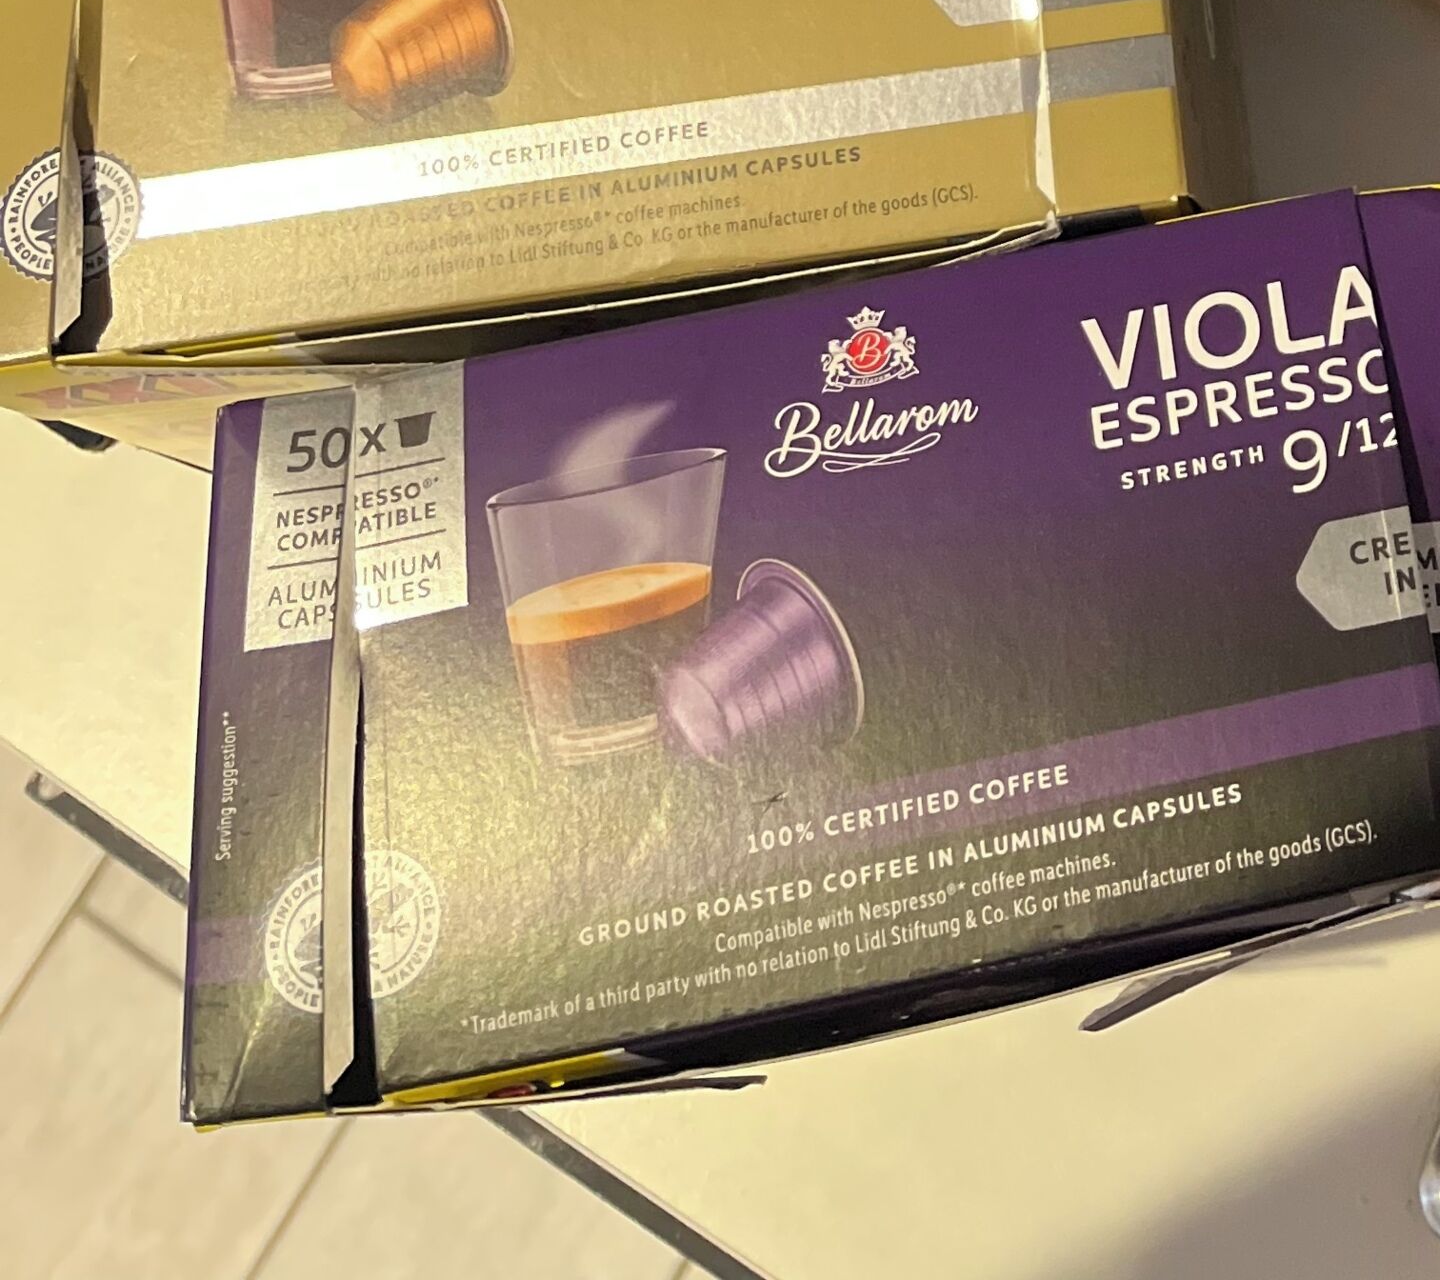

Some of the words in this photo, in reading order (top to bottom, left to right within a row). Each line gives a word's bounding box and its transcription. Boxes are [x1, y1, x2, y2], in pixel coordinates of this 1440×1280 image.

[420, 153, 480, 177] 100%
[489, 136, 610, 167] CERTIFIED
[620, 121, 709, 149] COFFEE
[579, 184, 601, 201] IN
[611, 163, 738, 196] ALUMINIUM
[746, 146, 861, 176] CAPSULES
[541, 239, 604, 260] Stiftung
[608, 234, 619, 250] &
[652, 227, 673, 243] KG
[677, 226, 692, 240] or
[697, 217, 722, 238] the
[726, 206, 829, 236] manufacturer
[833, 202, 848, 220] of
[853, 198, 876, 217] the
[881, 190, 928, 217] goods
[616, 205, 663, 224] coffee
[10, 235, 53, 271] PEOPLE
[1080, 265, 1378, 390] VIOLA
[764, 397, 979, 478] Bellarom
[1120, 444, 1264, 490] STRENGTH
[215, 807, 237, 861] Serving
[748, 820, 815, 855] 100%
[823, 788, 960, 837] CERTIFIED
[968, 764, 1069, 805] COFFEE
[579, 906, 687, 946] GROUND
[697, 878, 813, 922] ROASTED
[822, 854, 919, 893] COFFEE
[928, 846, 954, 871] IN
[964, 812, 1106, 863] ALUMINIUM
[1113, 783, 1243, 829] CAPSULES
[564, 993, 581, 1016] of
[584, 995, 596, 1012] a
[599, 981, 640, 1011] third
[646, 975, 691, 1004] party
[694, 965, 732, 989] with
[736, 960, 758, 979] no
[762, 939, 829, 974] relation
[834, 938, 851, 958] to
[856, 926, 888, 954] Lidl
[891, 913, 961, 946] Stiftung
[965, 907, 979, 930] &
[981, 901, 1010, 926] Co.
[1013, 894, 1038, 918] KG
[1042, 894, 1060, 914] or
[1063, 885, 1091, 908] the
[1095, 860, 1210, 900] manufacturer
[1215, 850, 1234, 875] of
[1236, 846, 1265, 872] the
[1268, 833, 1322, 868] goods
[1325, 818, 1379, 852] (GCS).
[715, 914, 813, 954] Compatible
[817, 906, 854, 932] with
[972, 870, 1026, 898] coffee
[1030, 851, 1117, 886] machines.
